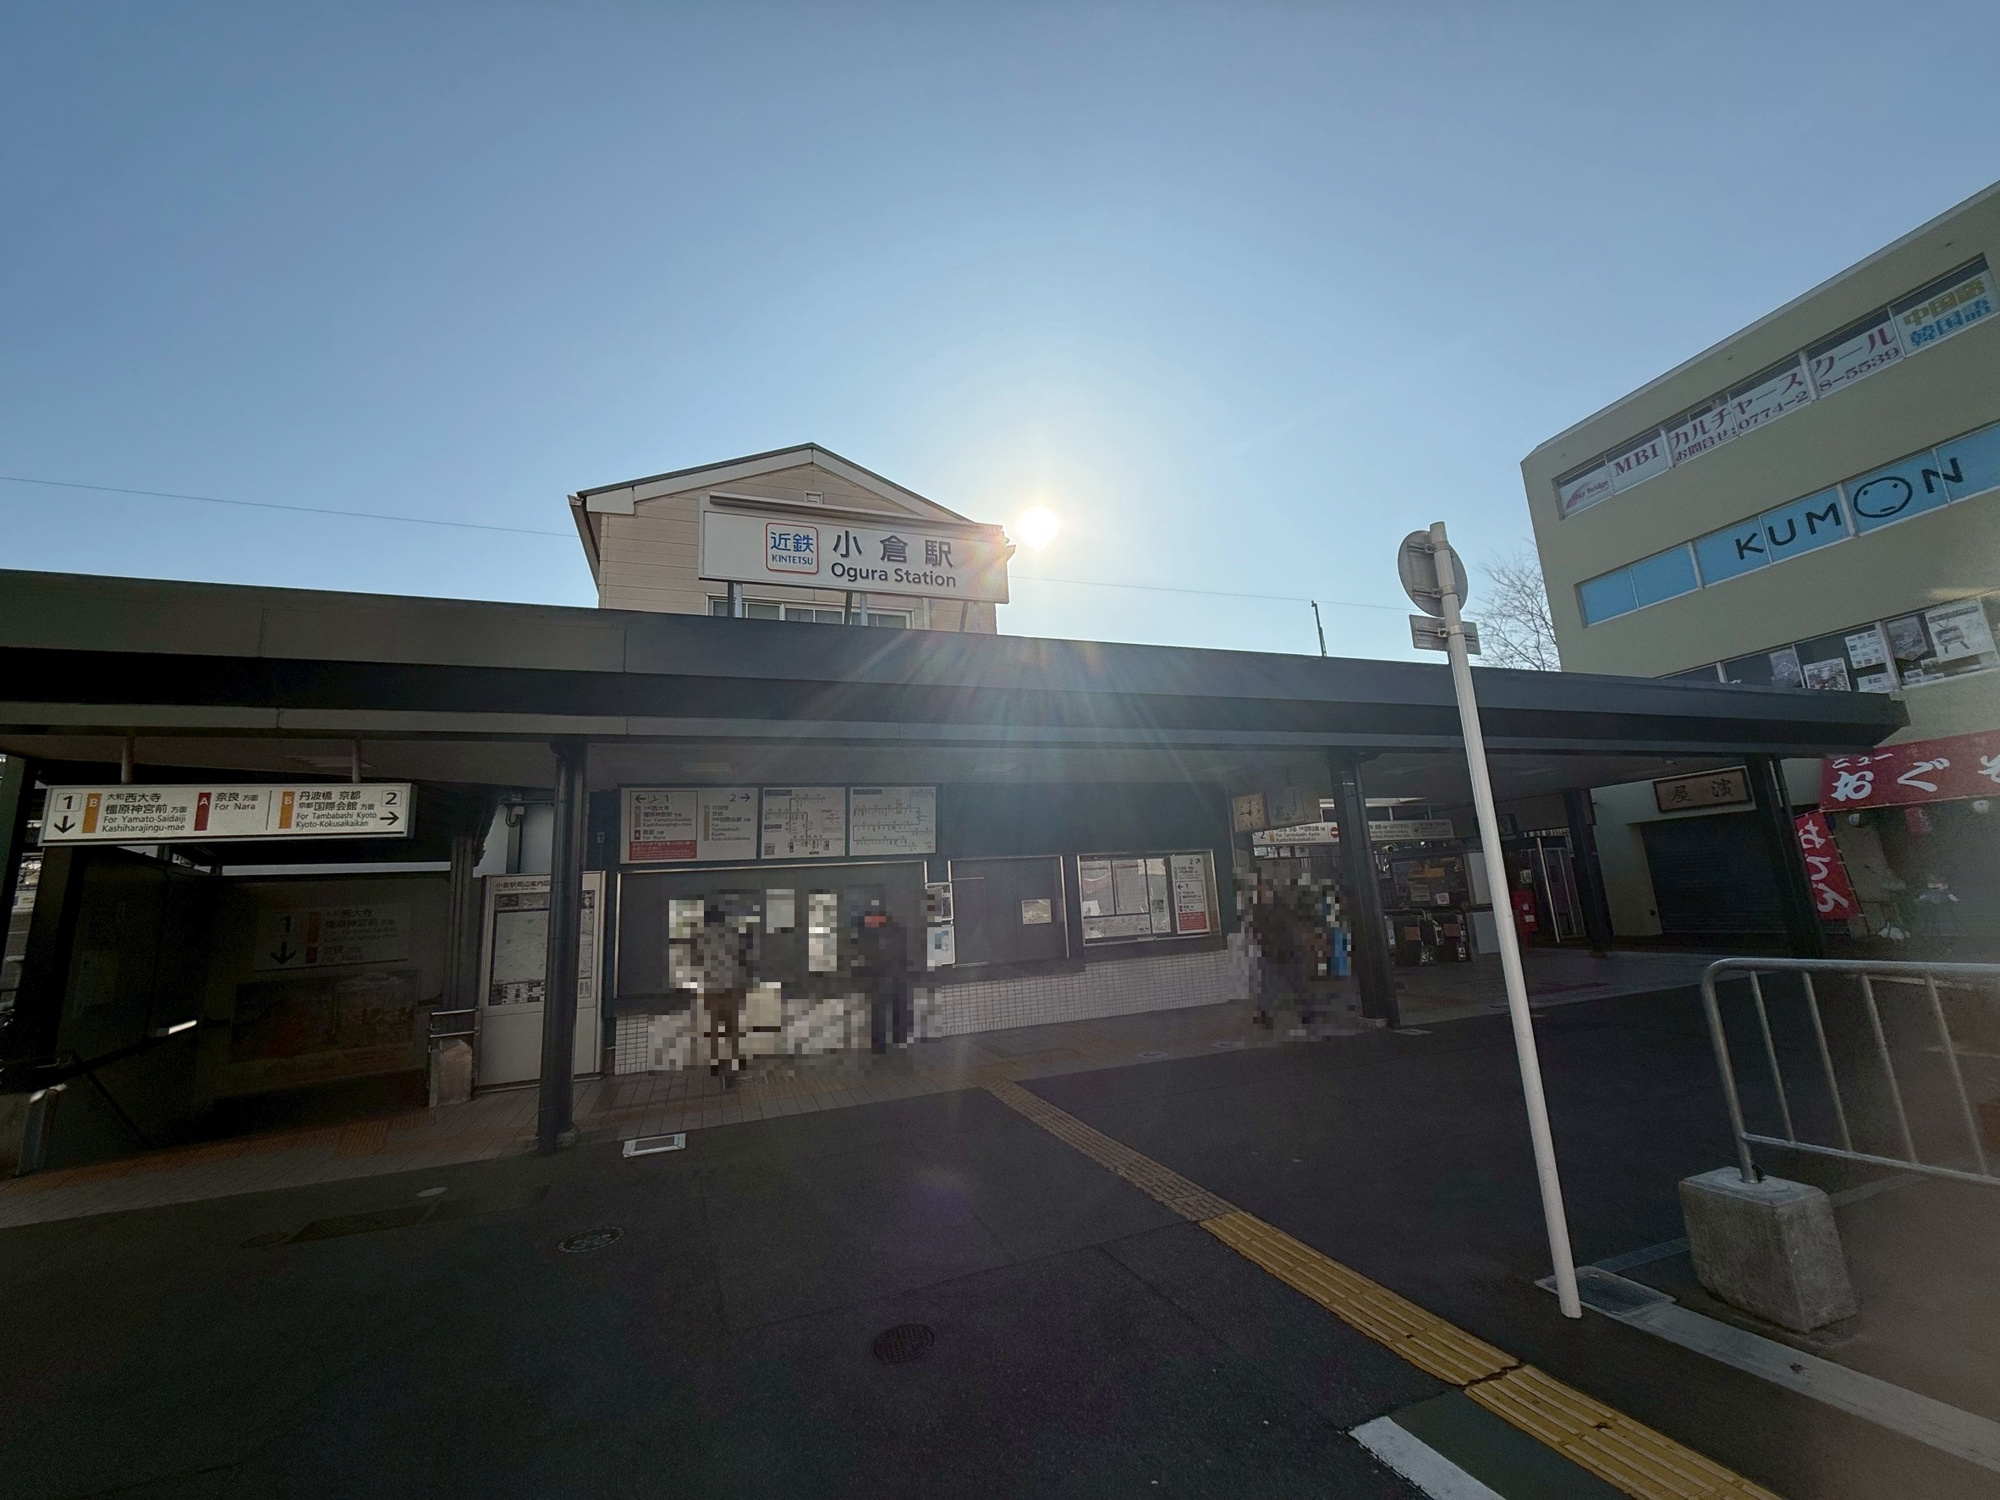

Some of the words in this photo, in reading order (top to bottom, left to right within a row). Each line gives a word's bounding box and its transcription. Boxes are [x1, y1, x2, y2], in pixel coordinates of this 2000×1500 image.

[1613, 442, 1661, 477] MBI
[1735, 457, 1964, 560] KUMON
[770, 531, 814, 555] 近鉄
[832, 530, 953, 569] 小倉駅
[772, 554, 813, 566] KINTETSU
[831, 562, 888, 582] Ogura
[894, 568, 957, 588] Station
[107, 793, 162, 803] 大和西大寺
[216, 792, 239, 802] 奈良
[284, 796, 292, 804] B
[299, 791, 332, 801] 丹波橋
[339, 791, 361, 800] 京都
[385, 792, 397, 805] 2
[730, 793, 736, 802] 2
[63, 795, 73, 810] 1
[89, 798, 98, 807] B
[199, 797, 209, 806] A
[234, 802, 256, 810] Nara
[104, 816, 119, 824] For
[122, 814, 186, 824] Yamato-Saidaiji
[312, 811, 354, 819] Tambabashi
[357, 811, 377, 820] Kyoto
[102, 824, 185, 834] Kashiharajingu-mae
[296, 820, 369, 829] Kyoto-Kokusaikaikan
